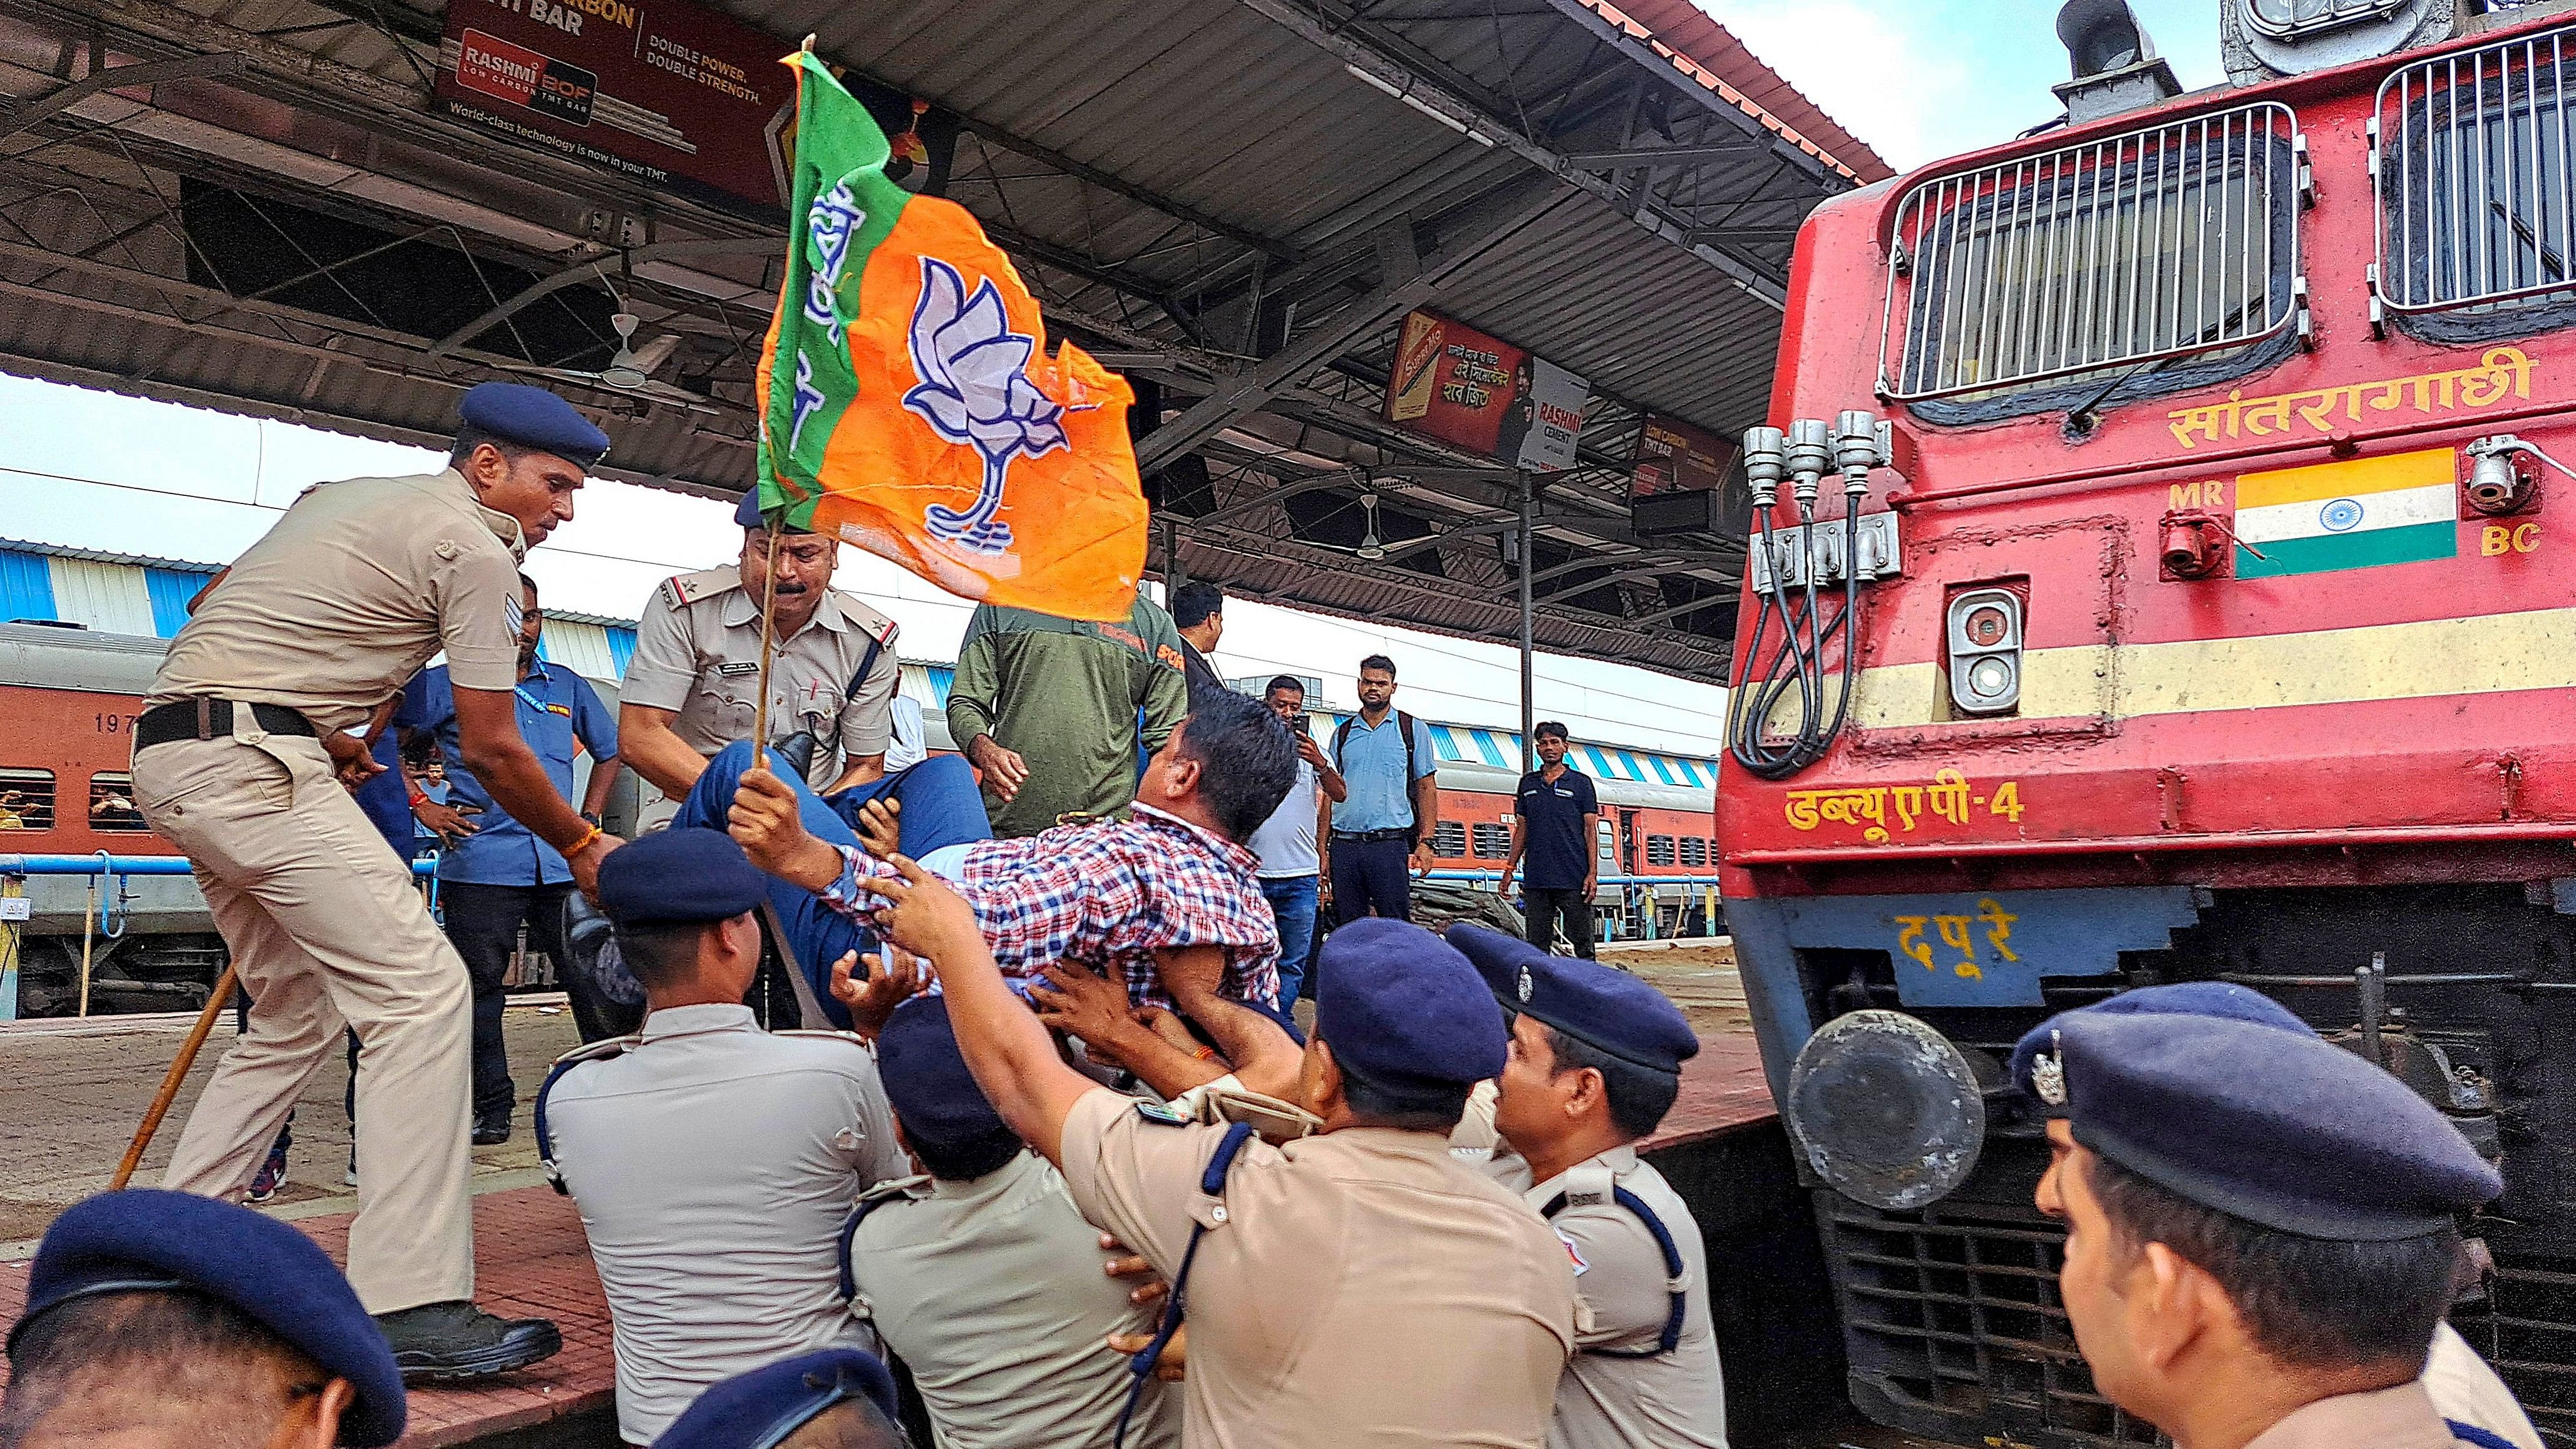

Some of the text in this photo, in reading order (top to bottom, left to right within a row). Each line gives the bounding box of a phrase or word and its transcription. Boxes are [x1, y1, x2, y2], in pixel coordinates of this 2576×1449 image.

[530, 0, 583, 36] BAR
[649, 35, 699, 64] DOUBLE
[463, 66, 587, 113] LOW CARBON TMT BAR
[647, 52, 761, 106] DOUBLE STRENGTH.
[450, 101, 515, 132] World-class
[517, 123, 575, 152] technology
[577, 143, 585, 155] is
[587, 150, 609, 164] now
[611, 154, 620, 166] in
[621, 160, 646, 175] your
[2167, 347, 2540, 450] सांतरागाछी
[1539, 402, 1583, 434] RASHMI
[2169, 480, 2225, 510] MR
[2480, 523, 2542, 557] BC
